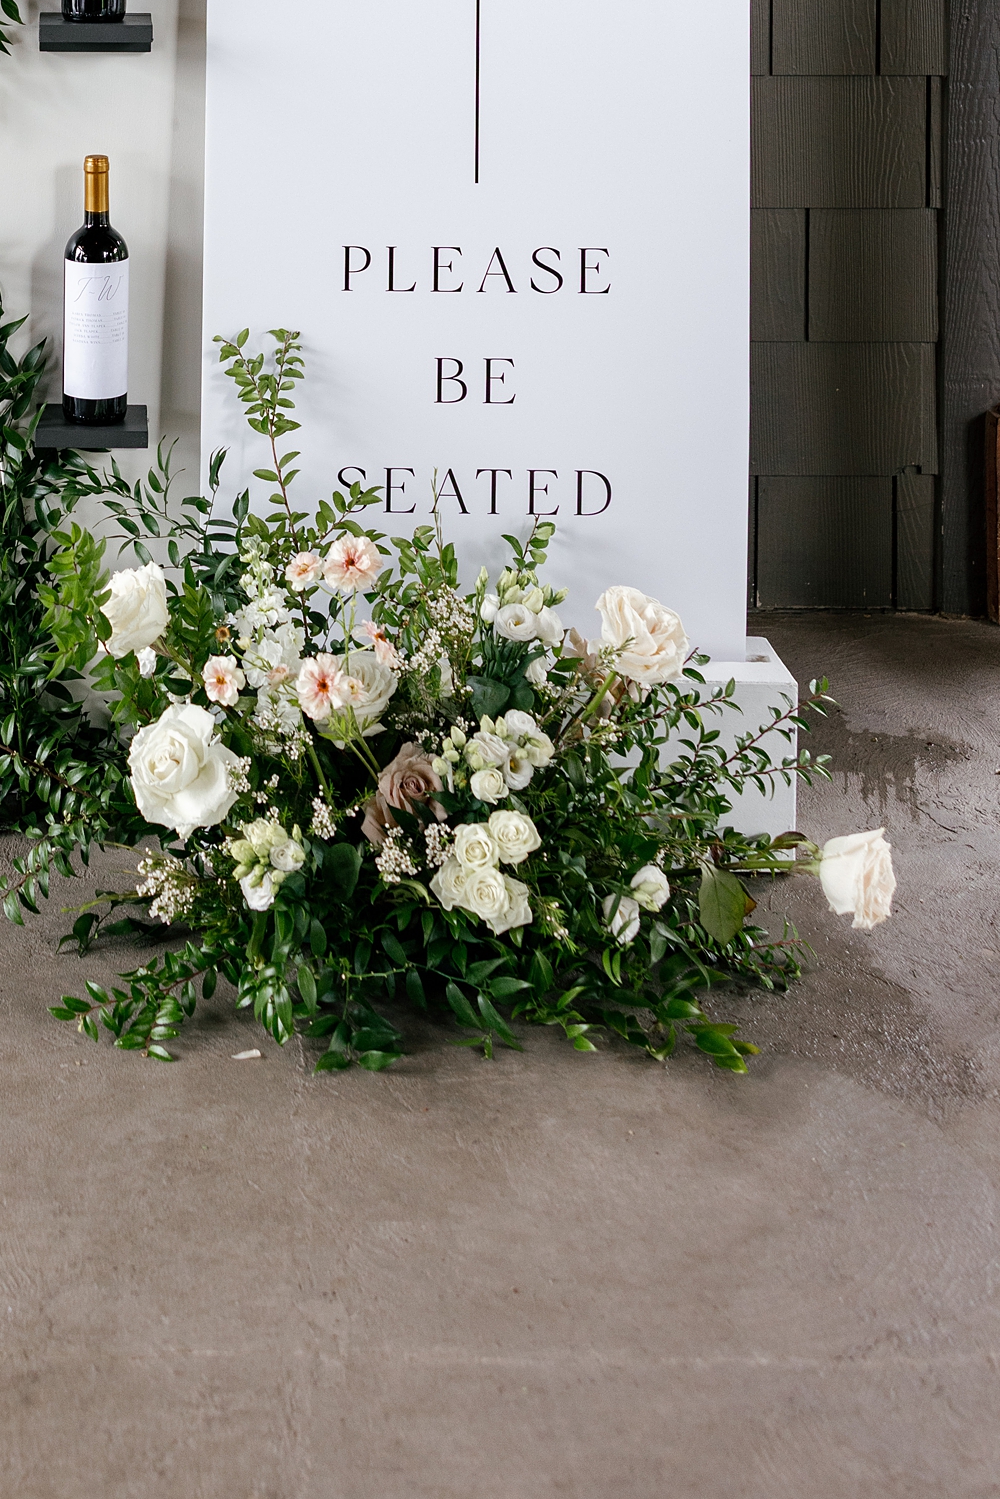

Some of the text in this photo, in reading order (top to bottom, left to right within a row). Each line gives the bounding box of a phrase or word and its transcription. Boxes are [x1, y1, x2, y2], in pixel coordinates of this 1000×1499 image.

[342, 246, 611, 293] PLEASE
[434, 358, 516, 404] BE
[337, 466, 611, 516] SEATED
